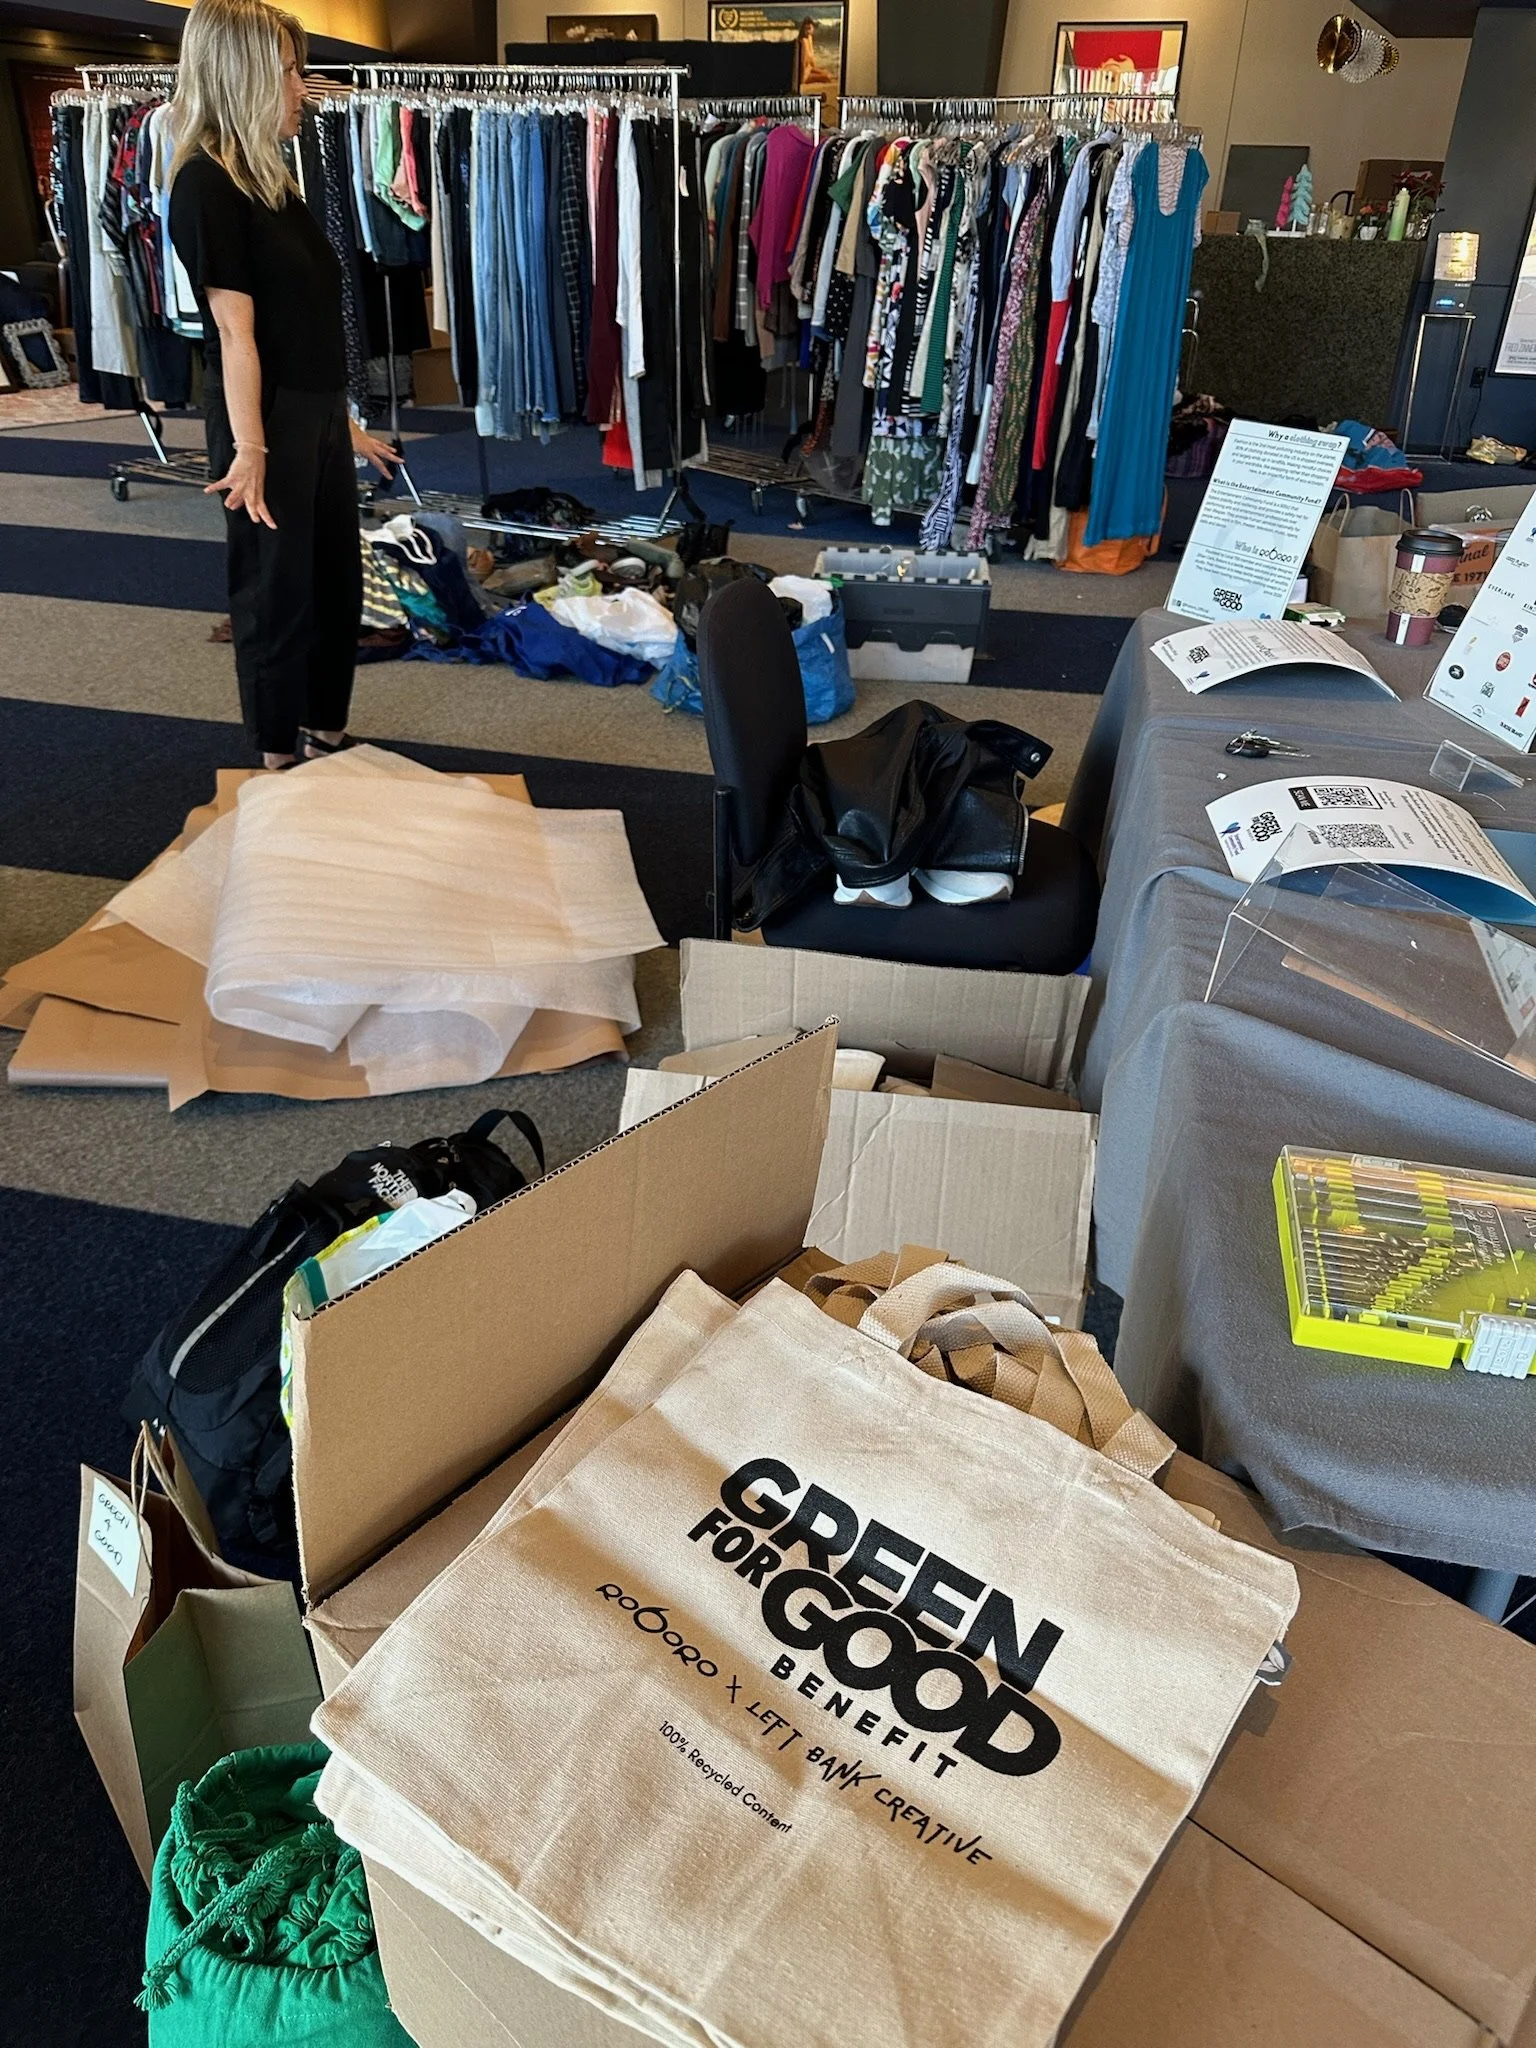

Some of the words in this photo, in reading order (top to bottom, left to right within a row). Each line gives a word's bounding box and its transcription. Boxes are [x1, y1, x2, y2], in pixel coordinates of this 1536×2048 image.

[1268, 430, 1282, 441] Why
[1290, 434, 1317, 447] clothing
[1239, 482, 1274, 495] Entertainment
[1275, 491, 1304, 503] Community
[1305, 496, 1321, 504] Fund?
[1213, 588, 1242, 601] GREEN
[1487, 583, 1515, 599] EVERLANE
[1219, 599, 1243, 611] GOOD
[1250, 821, 1271, 842] GOOD
[1259, 811, 1283, 836] GREEN
[368, 1176, 396, 1203] FACE
[370, 1162, 404, 1199] NORTH
[393, 1169, 414, 1191] THE
[98, 1493, 130, 1529] GREEN
[719, 1457, 1064, 1695] GREEN
[687, 1506, 783, 1589] FOR
[761, 1568, 1063, 1777] GOOD
[769, 1653, 959, 1780] BENEFIT
[658, 1719, 690, 1753] 100%
[687, 1747, 745, 1800] Recycled
[742, 1791, 794, 1834] Content
[725, 1674, 743, 1704] X
[745, 1701, 803, 1752] LEFT
[805, 1744, 882, 1791] BANK
[873, 1785, 993, 1867] CREATIVE
